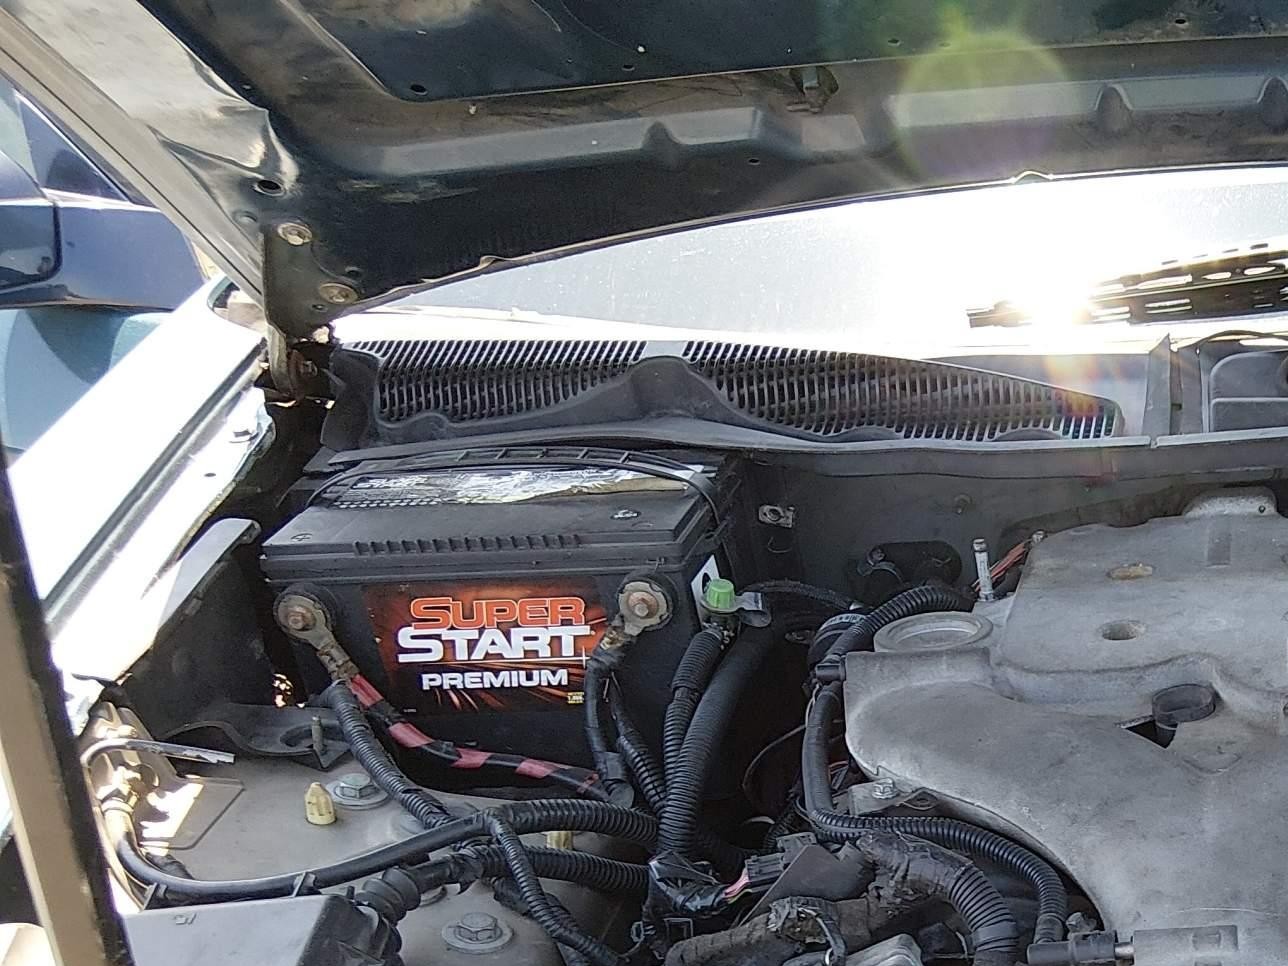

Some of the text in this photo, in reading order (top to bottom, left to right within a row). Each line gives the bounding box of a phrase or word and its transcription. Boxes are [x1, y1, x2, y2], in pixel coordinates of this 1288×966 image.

[410, 597, 585, 629] SUPER
[397, 626, 590, 663] START
[422, 669, 568, 690] PREMIUM
